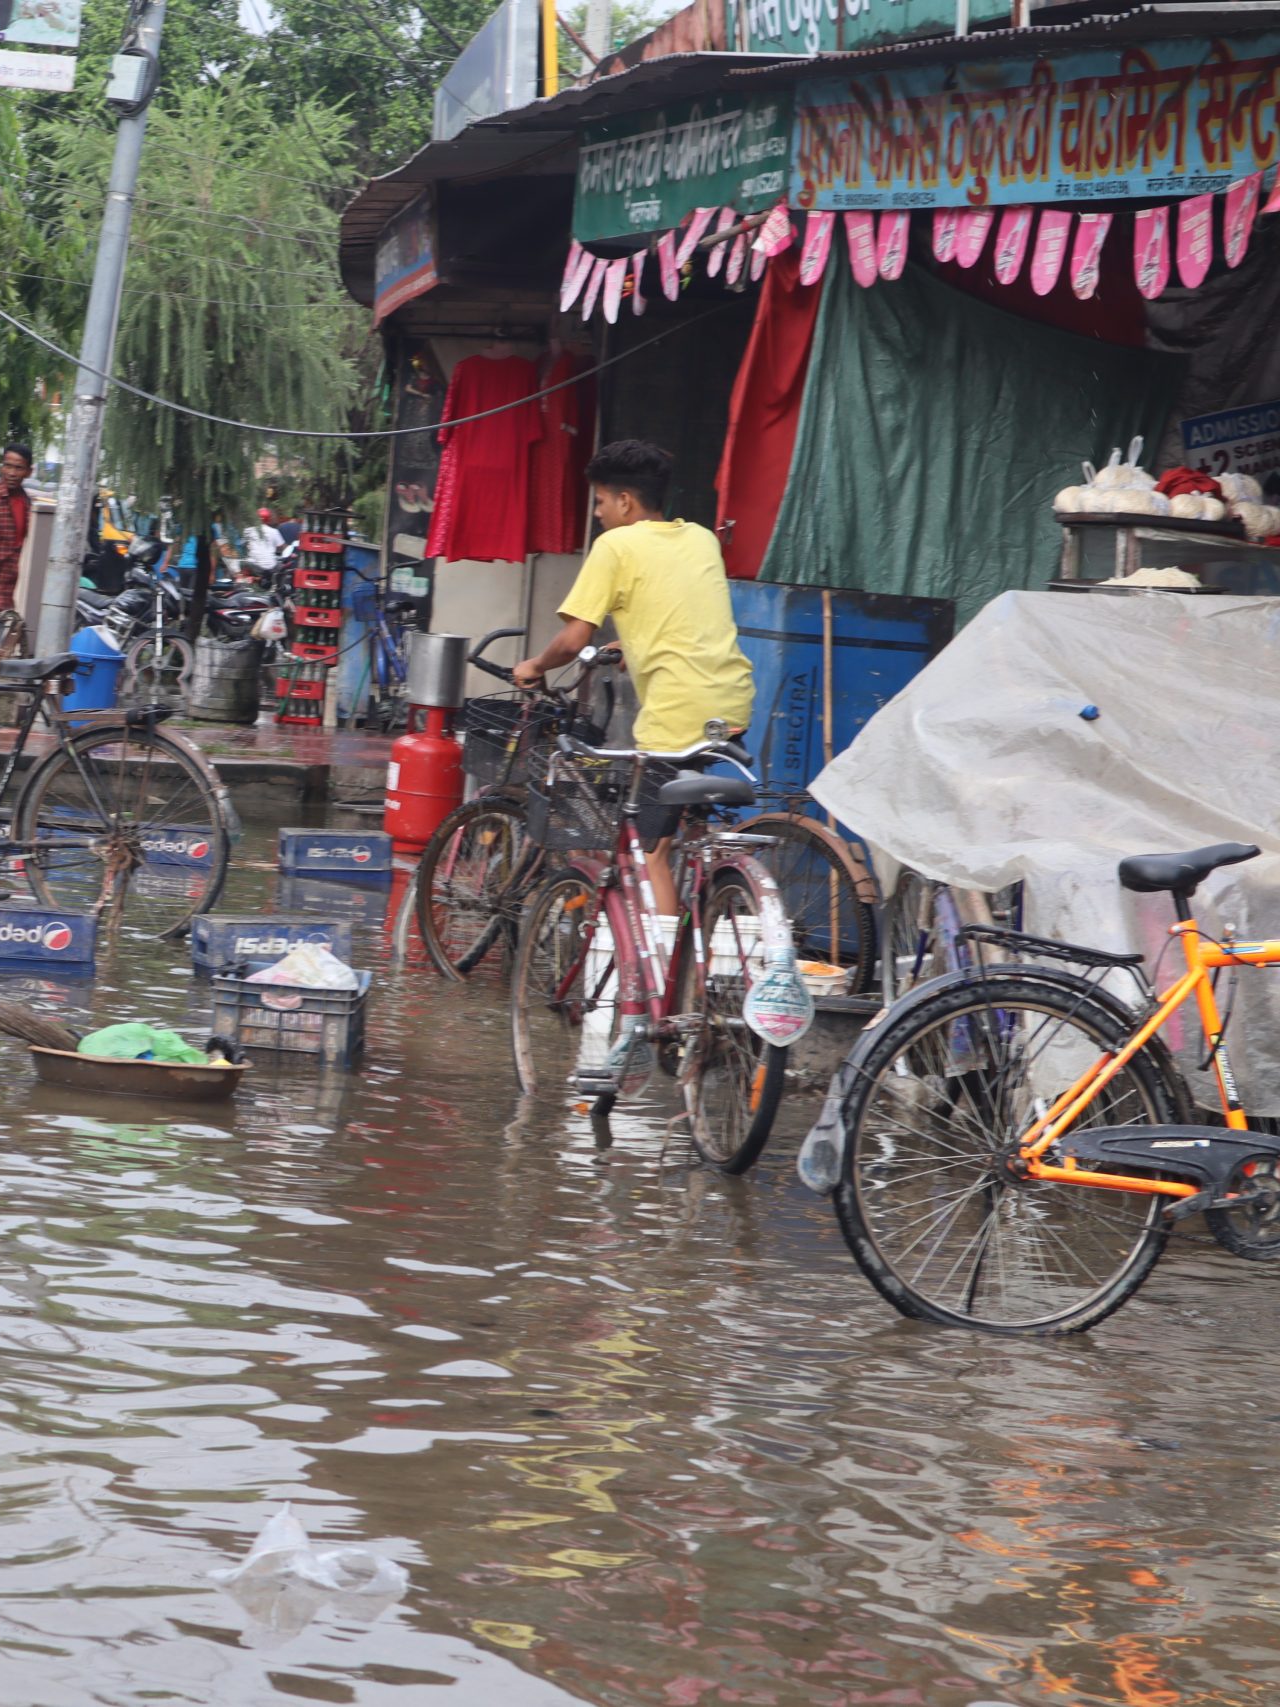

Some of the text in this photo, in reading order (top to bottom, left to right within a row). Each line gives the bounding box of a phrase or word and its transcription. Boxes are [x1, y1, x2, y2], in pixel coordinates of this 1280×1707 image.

[1196, 37, 1280, 172] सेन्ट
[1189, 408, 1280, 446] ADMISSIO
[785, 671, 809, 770] SPECTRA
[140, 839, 187, 853] peps
